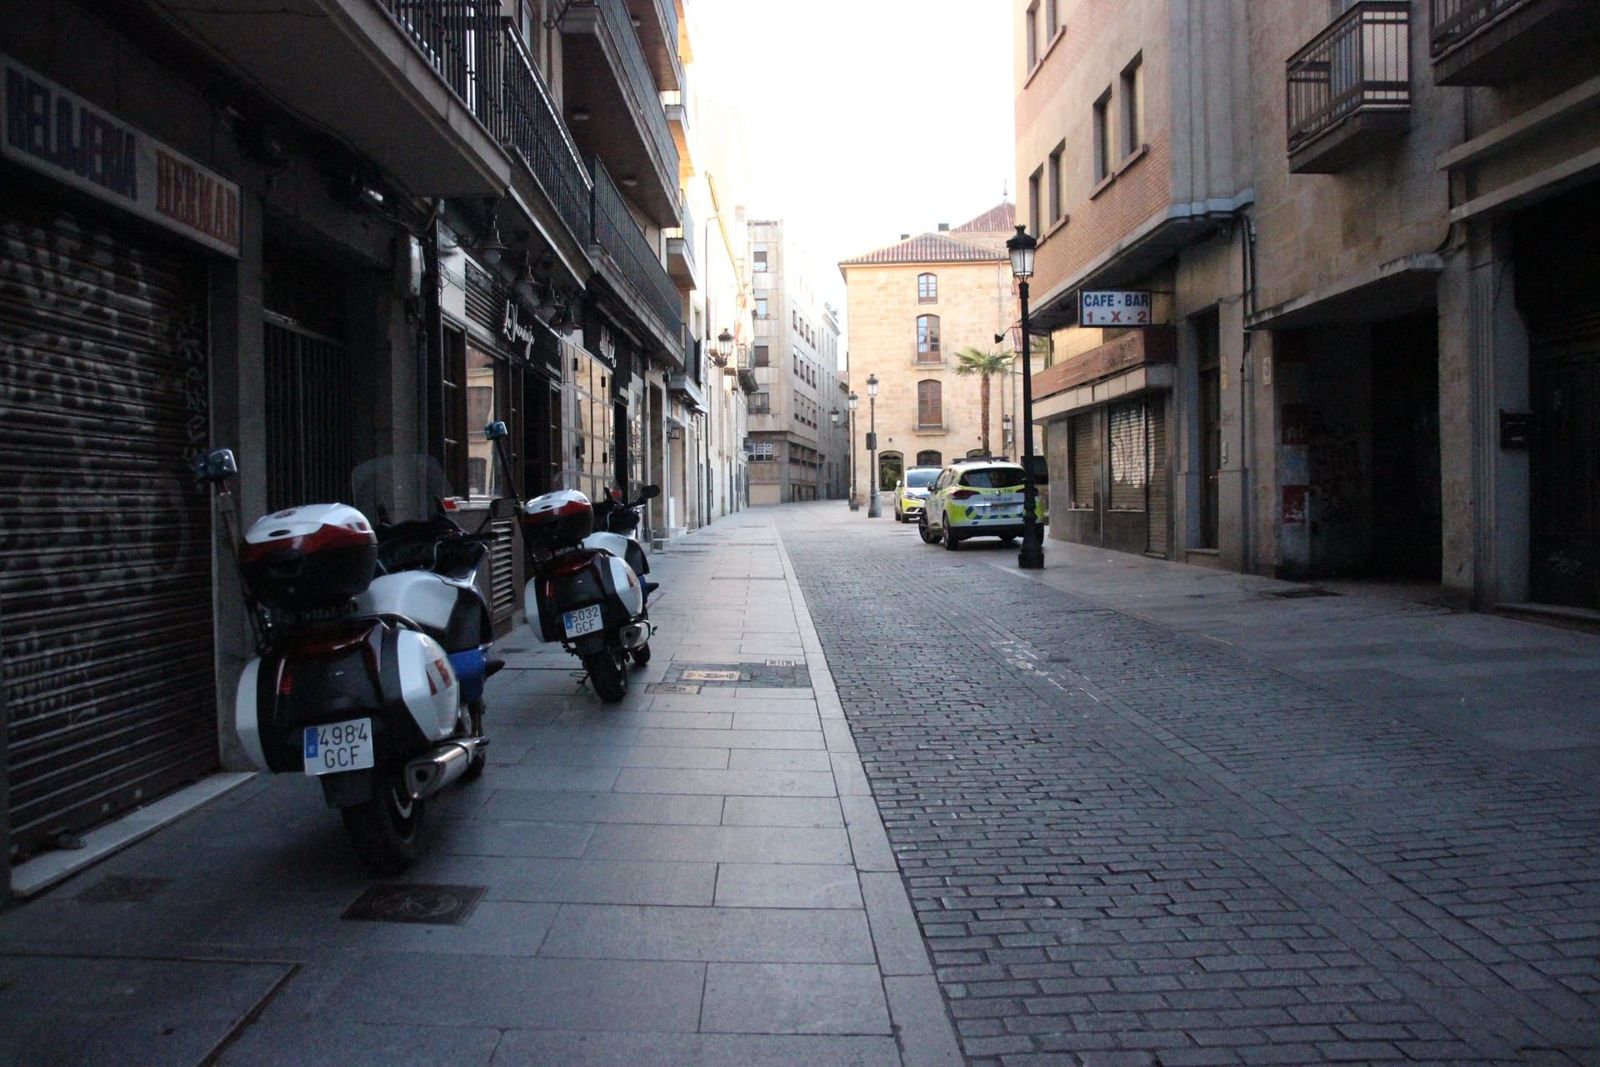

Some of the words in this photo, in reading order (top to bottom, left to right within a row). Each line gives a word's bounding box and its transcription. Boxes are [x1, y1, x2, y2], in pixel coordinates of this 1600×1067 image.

[1084, 294, 1114, 307] CAFE
[1125, 294, 1149, 307] BAR
[572, 607, 598, 623] 5032
[576, 620, 594, 633] GCF
[320, 724, 368, 746] 4984
[325, 744, 360, 768] GCF
